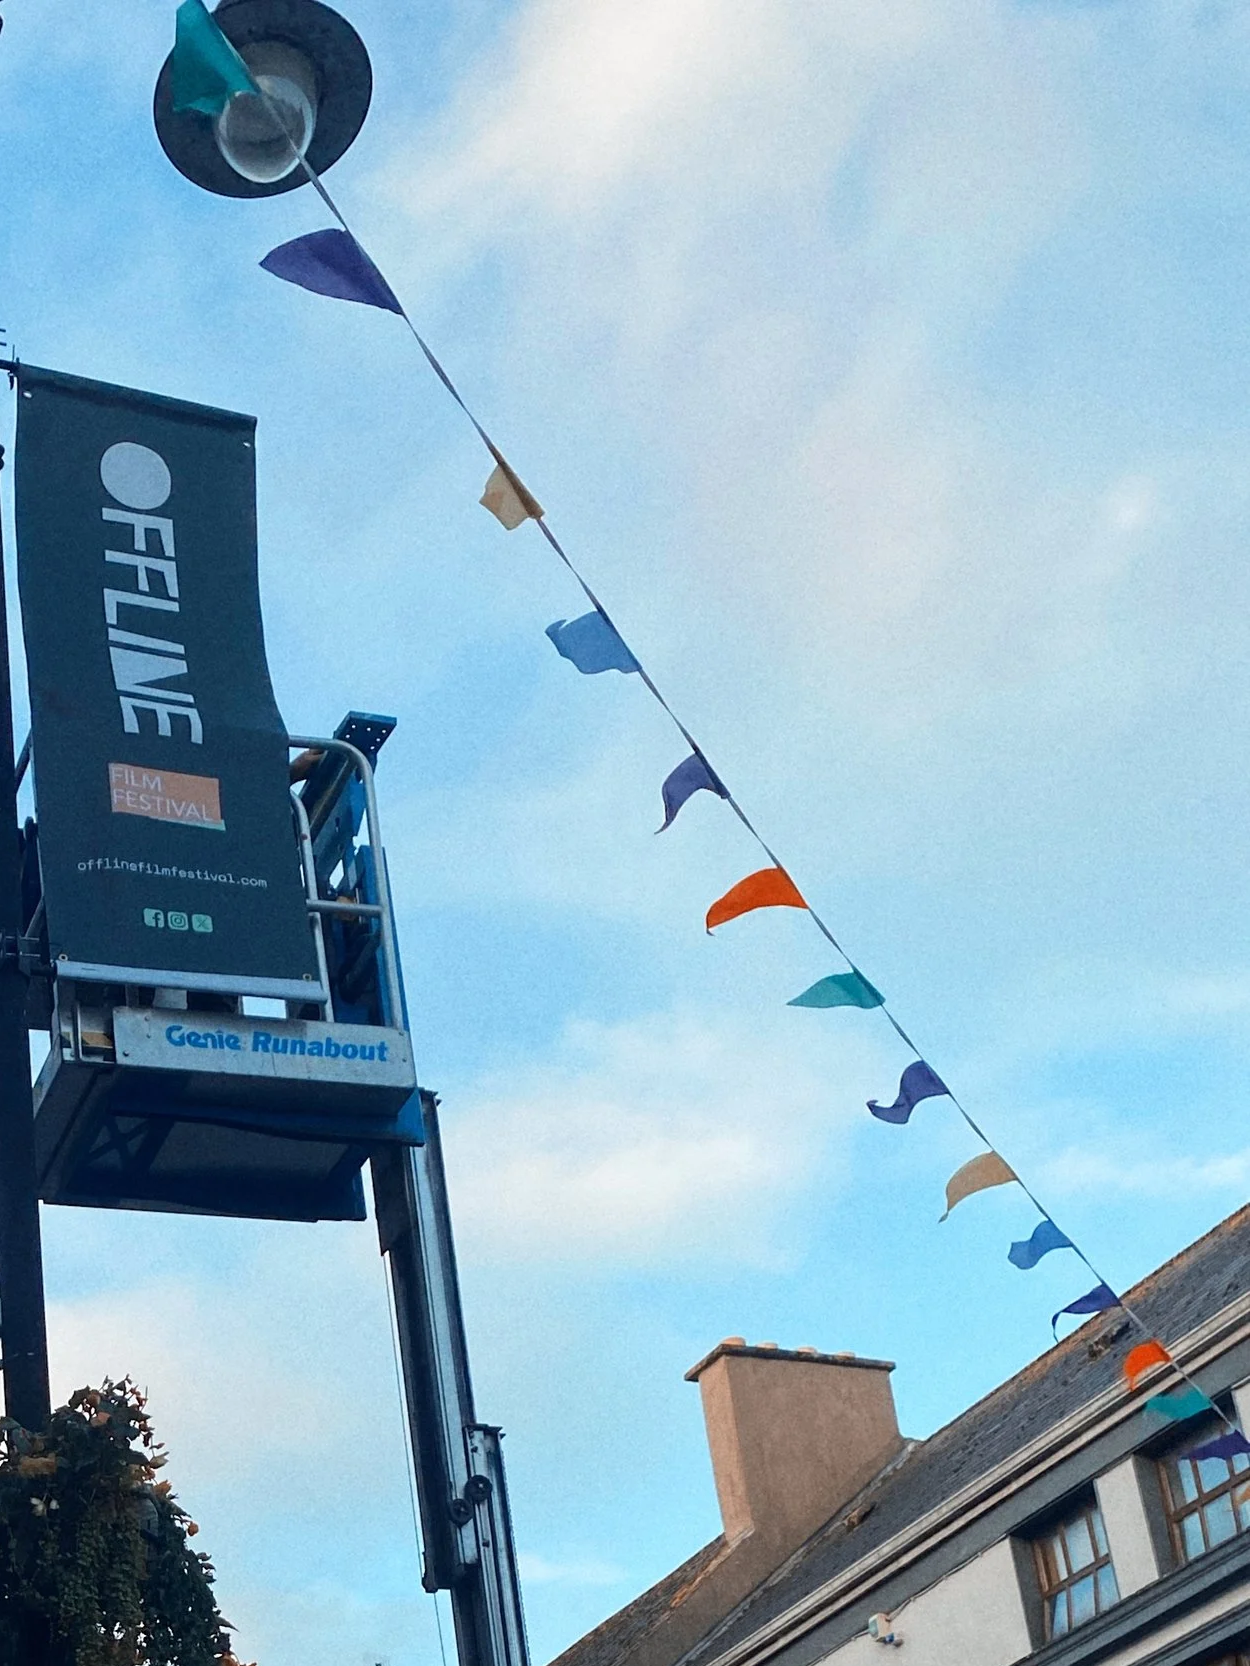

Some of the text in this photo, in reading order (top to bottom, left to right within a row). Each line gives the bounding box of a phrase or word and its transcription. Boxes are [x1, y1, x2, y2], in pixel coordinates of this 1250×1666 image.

[100, 442, 203, 744] OFFLINE
[111, 766, 162, 792] FILM
[112, 788, 214, 822] FESTIVAL
[77, 857, 268, 888] offlinefilmfestival.com
[165, 1024, 388, 1062] Genie Runabout
